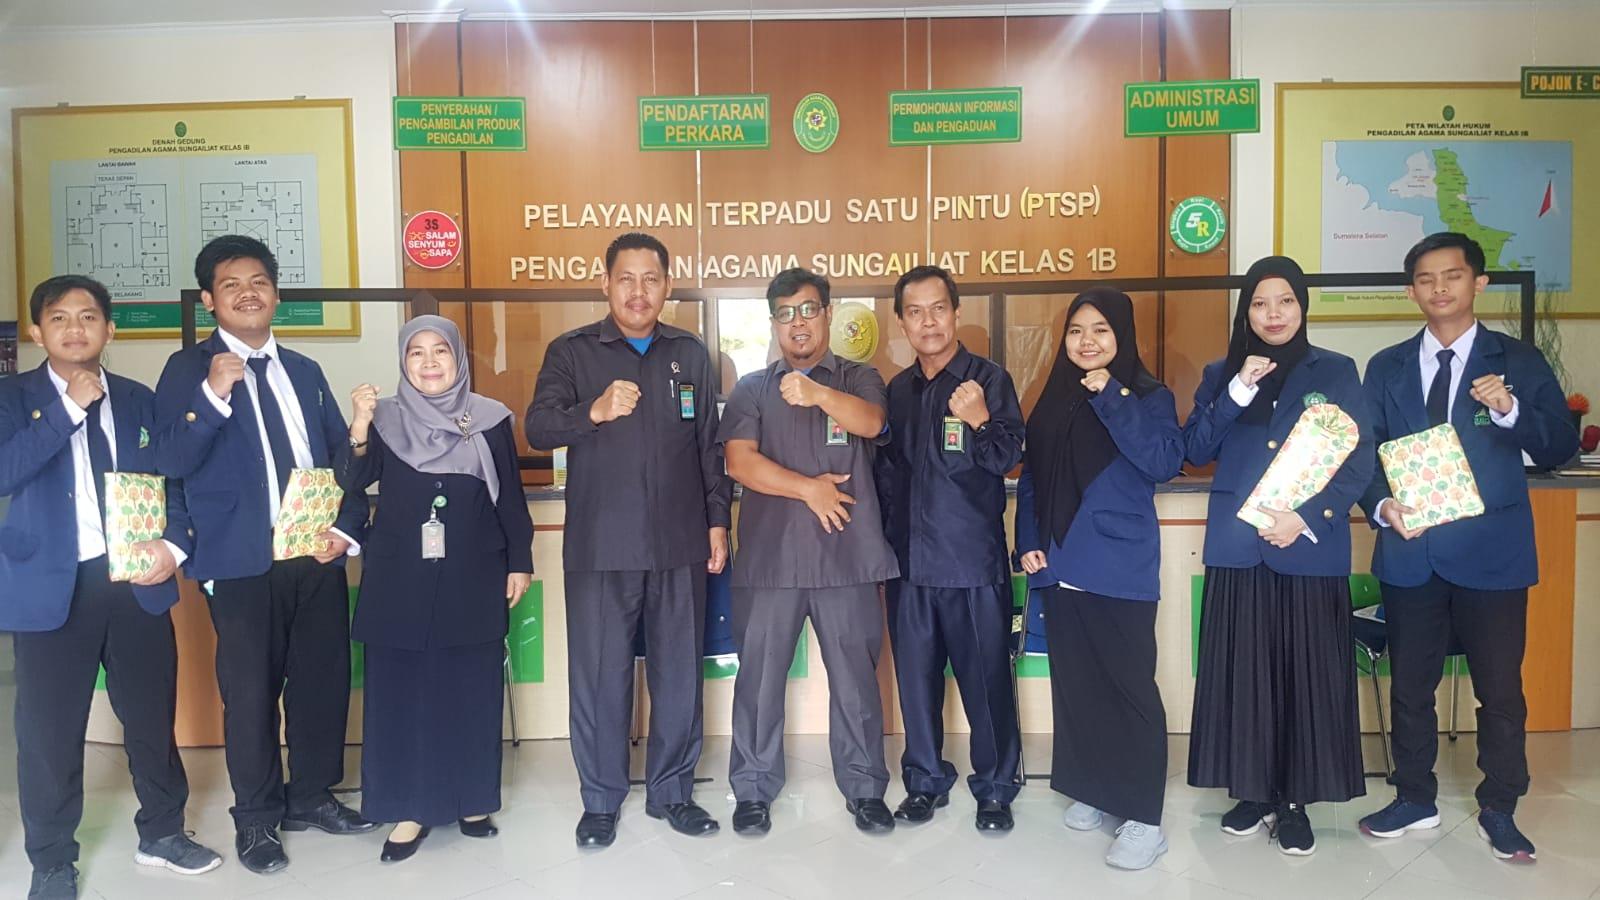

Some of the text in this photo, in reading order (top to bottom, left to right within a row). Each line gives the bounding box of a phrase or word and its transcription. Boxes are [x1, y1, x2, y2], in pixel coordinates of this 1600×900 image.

[1531, 75, 1572, 91] POJOK
[1130, 88, 1255, 108] ADMINISTRASI
[421, 104, 492, 115] PENYERAHAN
[643, 103, 764, 122] PENDAFTARAN
[893, 100, 1017, 116] PERMOHONAN INFORMASI
[400, 118, 520, 130] PENGAMBILAN PRODUK
[913, 120, 996, 133] DAN PENGADUAN
[1166, 110, 1219, 128] UMUM
[427, 132, 493, 144] PENGADILAN
[665, 124, 744, 143] PERKARA
[524, 184, 1101, 229] PELAYANAN TERPADU SATU PINTU (PTSP)
[424, 218, 439, 230] 3S
[1186, 212, 1210, 237] 5R
[425, 231, 456, 240] SALAM
[408, 240, 446, 249] SENYUM
[429, 249, 452, 257] SAPA
[510, 255, 693, 281] PENGAN
[704, 253, 800, 278] AGAMA
[980, 247, 1074, 274] KELAS
[1087, 247, 1117, 272] 1B
